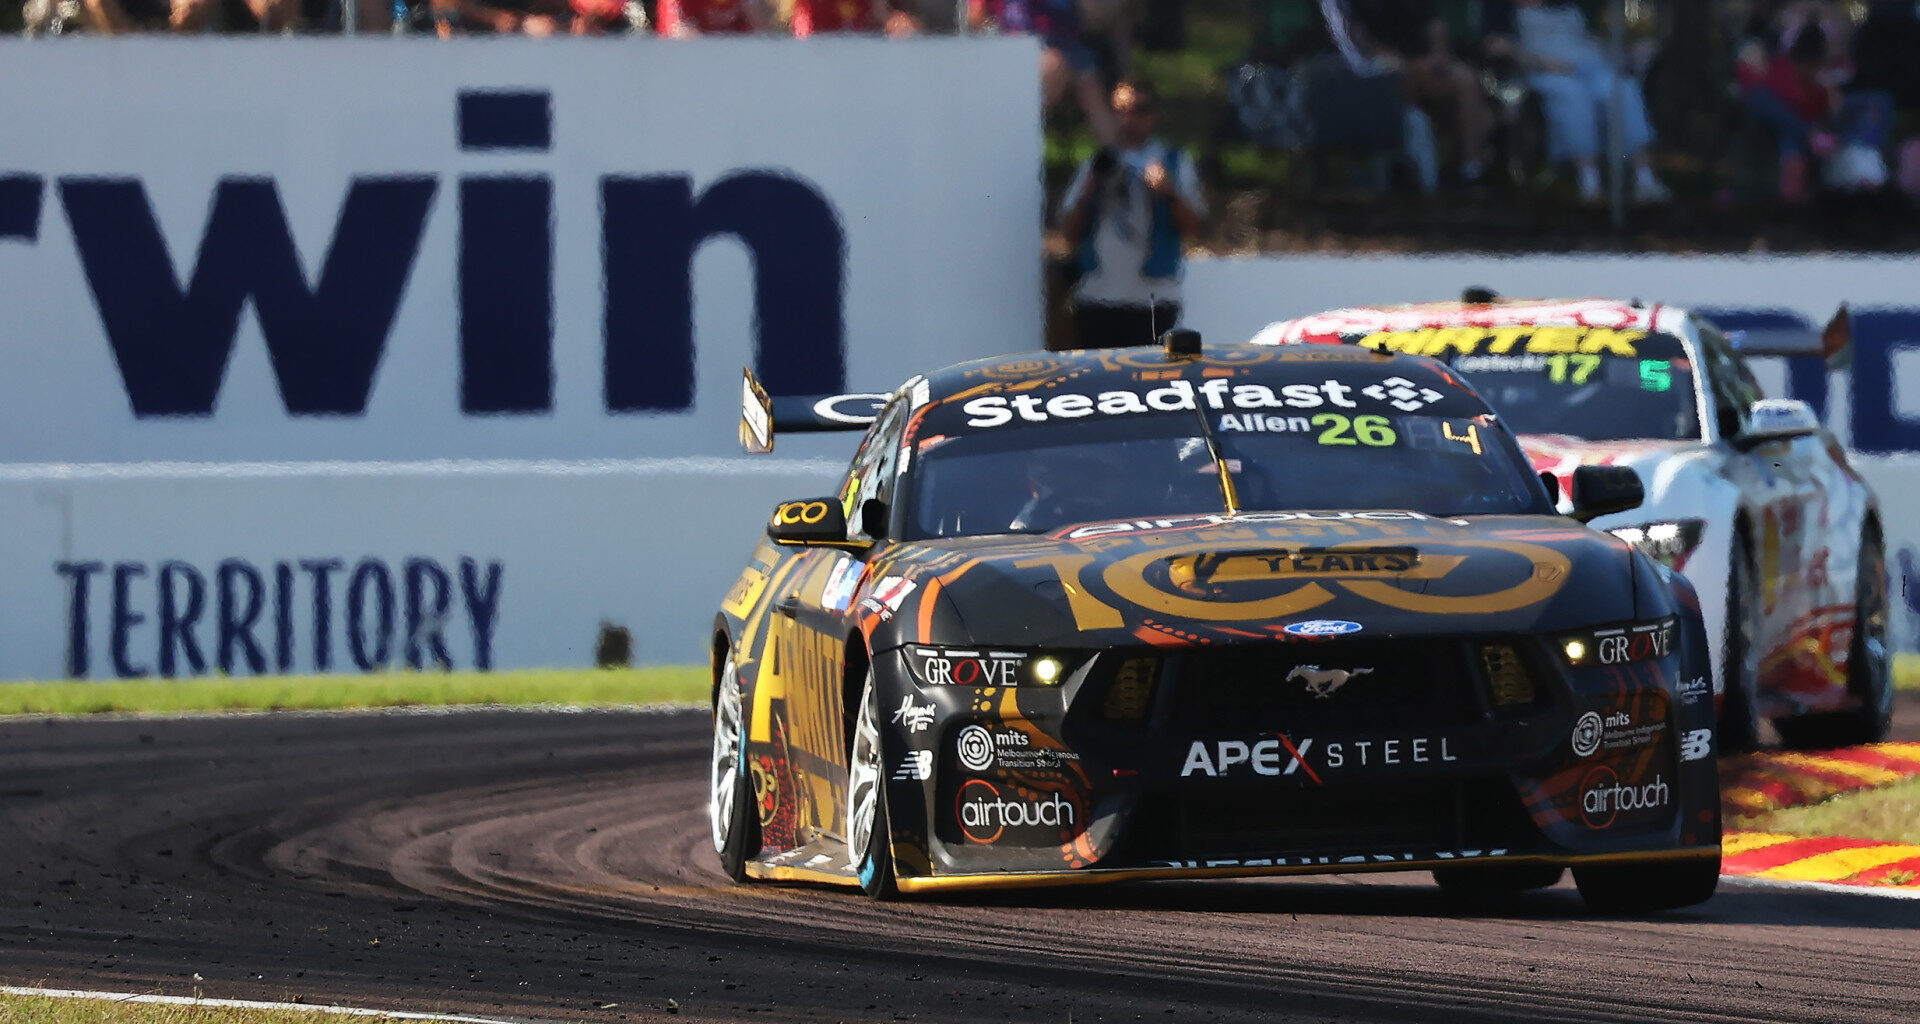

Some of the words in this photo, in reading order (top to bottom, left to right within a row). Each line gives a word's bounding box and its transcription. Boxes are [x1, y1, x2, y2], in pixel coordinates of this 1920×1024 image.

[1546, 353, 1602, 385] 17
[1638, 359, 1673, 393] 5
[963, 378, 1357, 428] Steadfast
[1218, 412, 1311, 433] Allen
[1311, 412, 1397, 446] 26
[1442, 421, 1482, 455] 4
[1258, 554, 1410, 573] YEARS
[55, 556, 503, 680] TERRITORY
[1298, 620, 1348, 634] Ford
[1599, 629, 1671, 664] GROVE
[1605, 711, 1630, 727] mits
[996, 732, 1028, 746] mits
[1181, 734, 1322, 784] APEX
[1326, 737, 1457, 768] STEEL
[962, 791, 1074, 827] airtouch
[1583, 774, 1669, 813] airtouch
